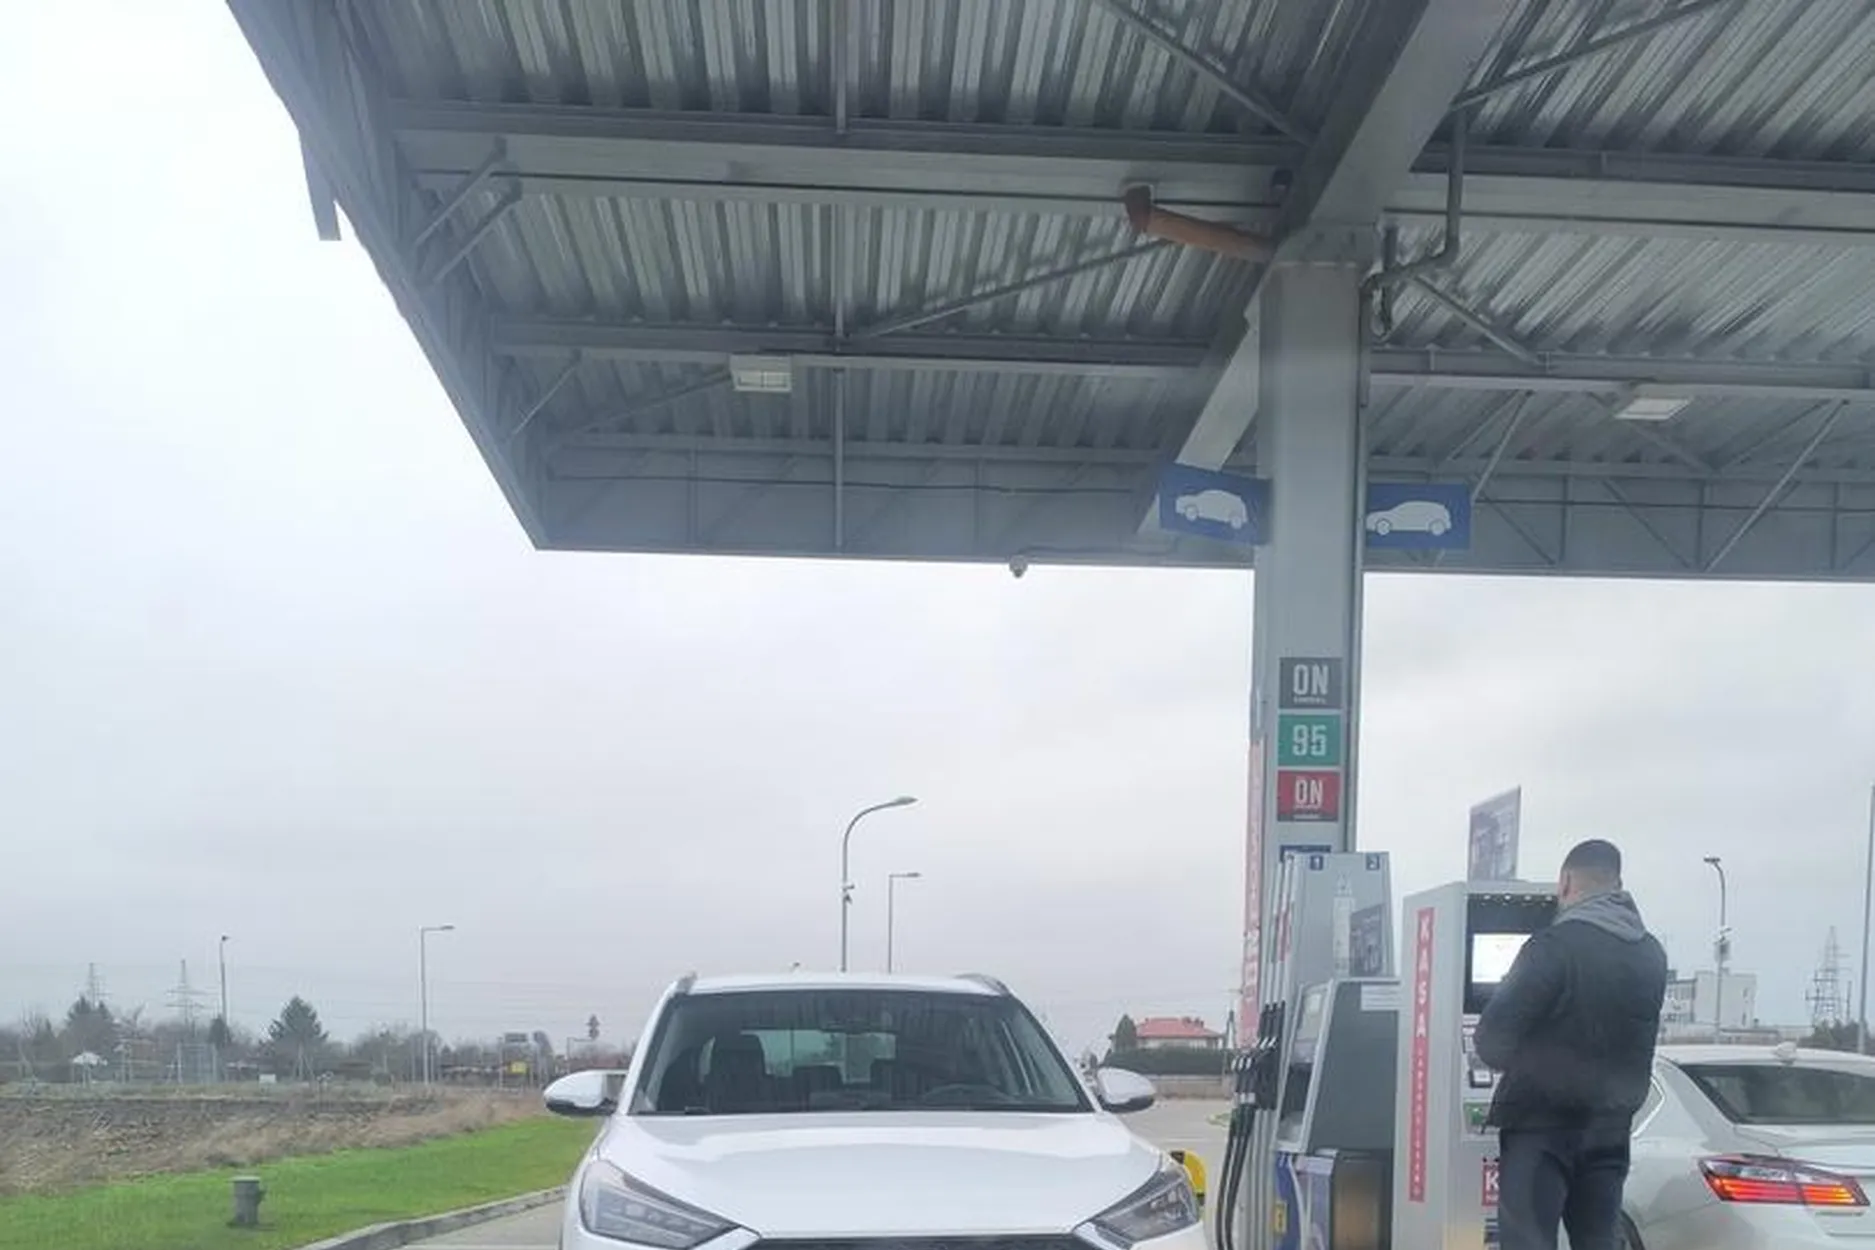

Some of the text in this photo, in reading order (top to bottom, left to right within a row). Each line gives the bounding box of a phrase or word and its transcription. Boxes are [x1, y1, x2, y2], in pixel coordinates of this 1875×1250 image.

[1293, 664, 1329, 696] ON
[1292, 725, 1327, 756] 95
[1295, 779, 1323, 805] ON
[1415, 912, 1432, 1036] KASA
